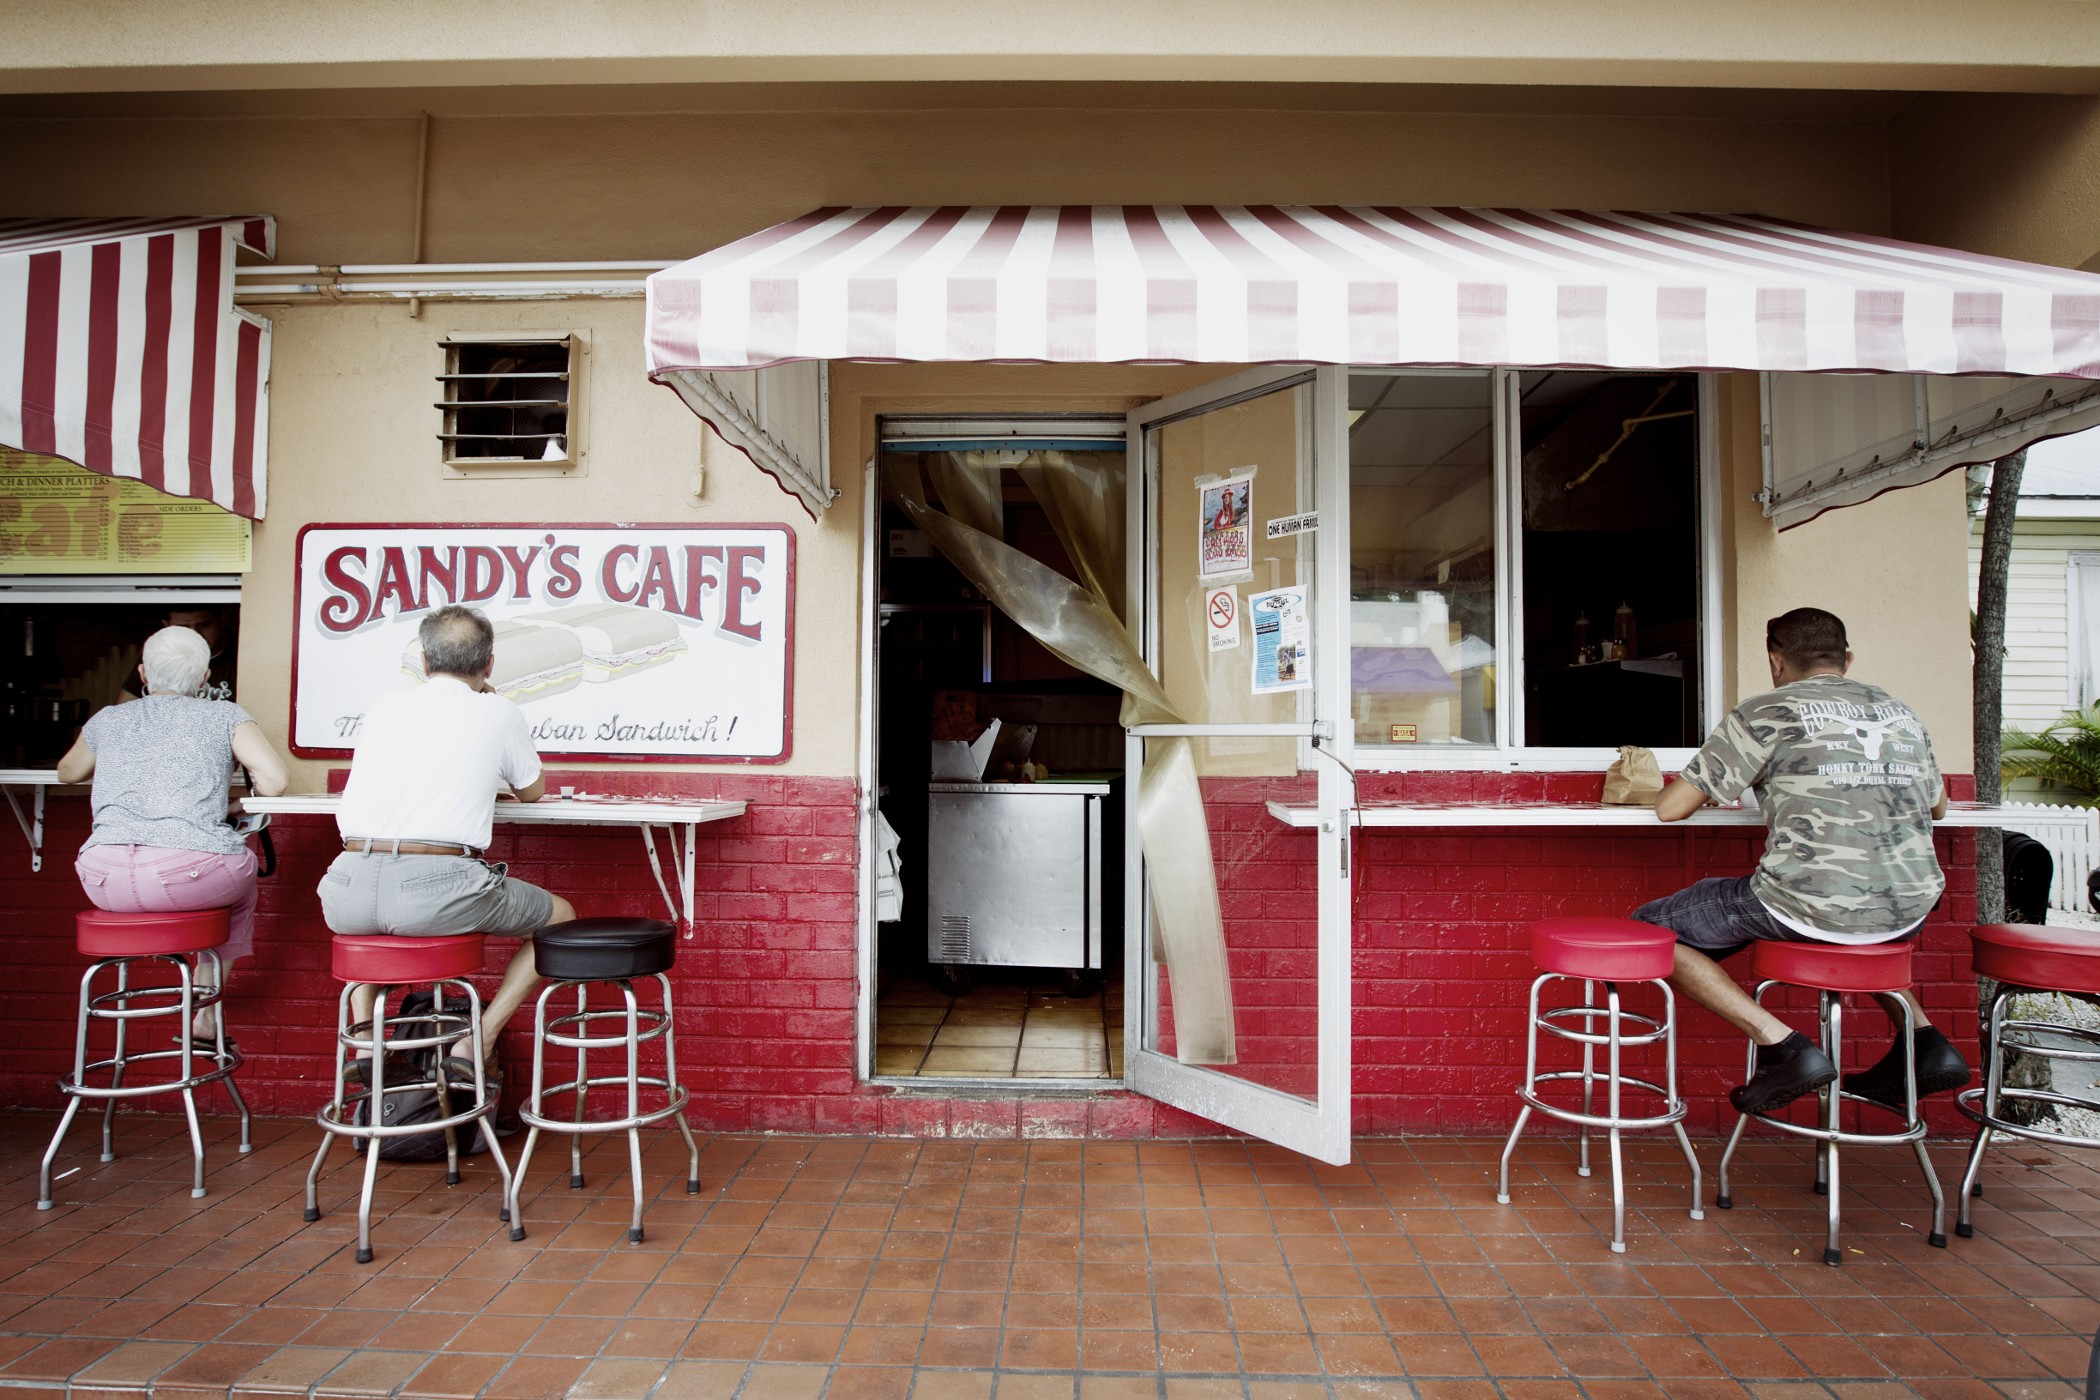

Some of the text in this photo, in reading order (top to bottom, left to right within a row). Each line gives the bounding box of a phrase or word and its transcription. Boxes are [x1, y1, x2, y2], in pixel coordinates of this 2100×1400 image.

[26, 477, 64, 486] DINNER
[65, 477, 110, 486] PLATTERS
[1269, 523, 1280, 536] ONE
[1281, 520, 1302, 534] HUMAN
[1303, 517, 1318, 530] FAMIL
[320, 534, 582, 633] SANDY'S
[602, 544, 766, 641] CAFE
[1211, 637, 1236, 648] SMOKING
[1799, 702, 1868, 737] COWBOY
[334, 715, 360, 738] Th
[529, 717, 587, 740] uban
[1826, 741, 1914, 753] KEY WEST
[1818, 763, 1921, 776] HONKY TONK SALOON
[1863, 776, 1886, 784] DUVAL
